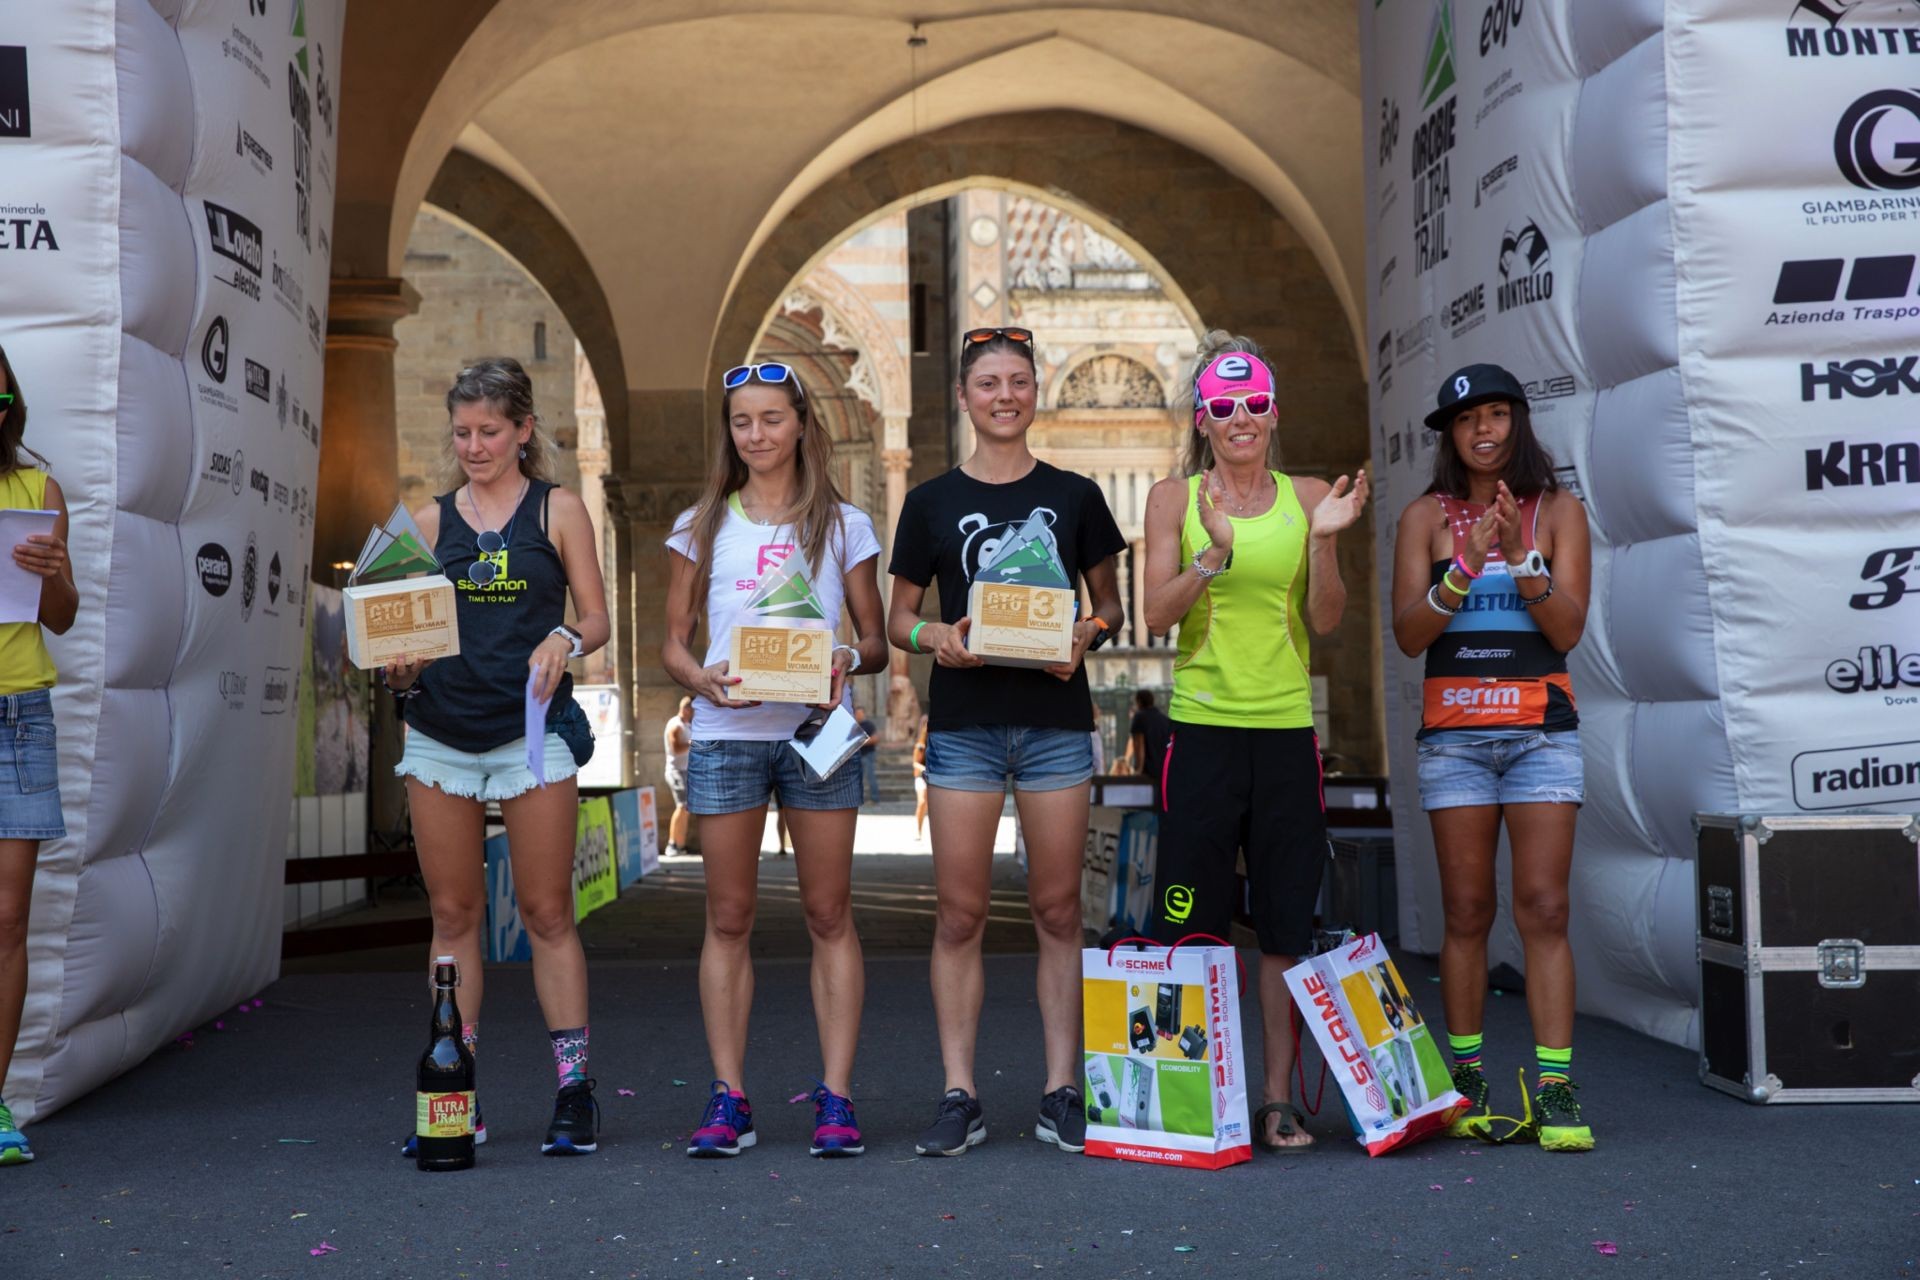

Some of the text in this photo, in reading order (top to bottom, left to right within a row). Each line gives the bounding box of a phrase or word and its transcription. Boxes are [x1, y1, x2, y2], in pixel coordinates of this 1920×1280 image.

[1414, 156, 1451, 228] ULTRA
[1806, 217, 1818, 226] IL
[1823, 213, 1877, 225] FUTURO
[1882, 210, 1906, 221] PER
[217, 207, 262, 276] Lovato
[1415, 212, 1449, 278] TRAIL
[233, 268, 261, 302] electric
[1497, 271, 1553, 314] MONTELLO
[1764, 305, 1920, 325] Azienda Traspo
[210, 452, 232, 475] SIDAS
[1805, 440, 1920, 491] KRA
[457, 579, 527, 591] saomon
[467, 594, 516, 602] TIME TO PLAY
[414, 620, 447, 630] WOMAN
[1029, 619, 1062, 629] WOMAN
[787, 661, 820, 671] WOMAN
[1442, 686, 1520, 706] serim
[1884, 696, 1918, 706] Dove
[1125, 959, 1165, 971] SCAME
[1219, 963, 1234, 1086] electrical solutions
[1302, 972, 1373, 1086] SCAME
[1161, 1063, 1201, 1074] ECOMOBILITY
[433, 1101, 465, 1113] ULTRA
[434, 1112, 465, 1125] TRAIL
[1115, 1145, 1183, 1162] www.scame.com
